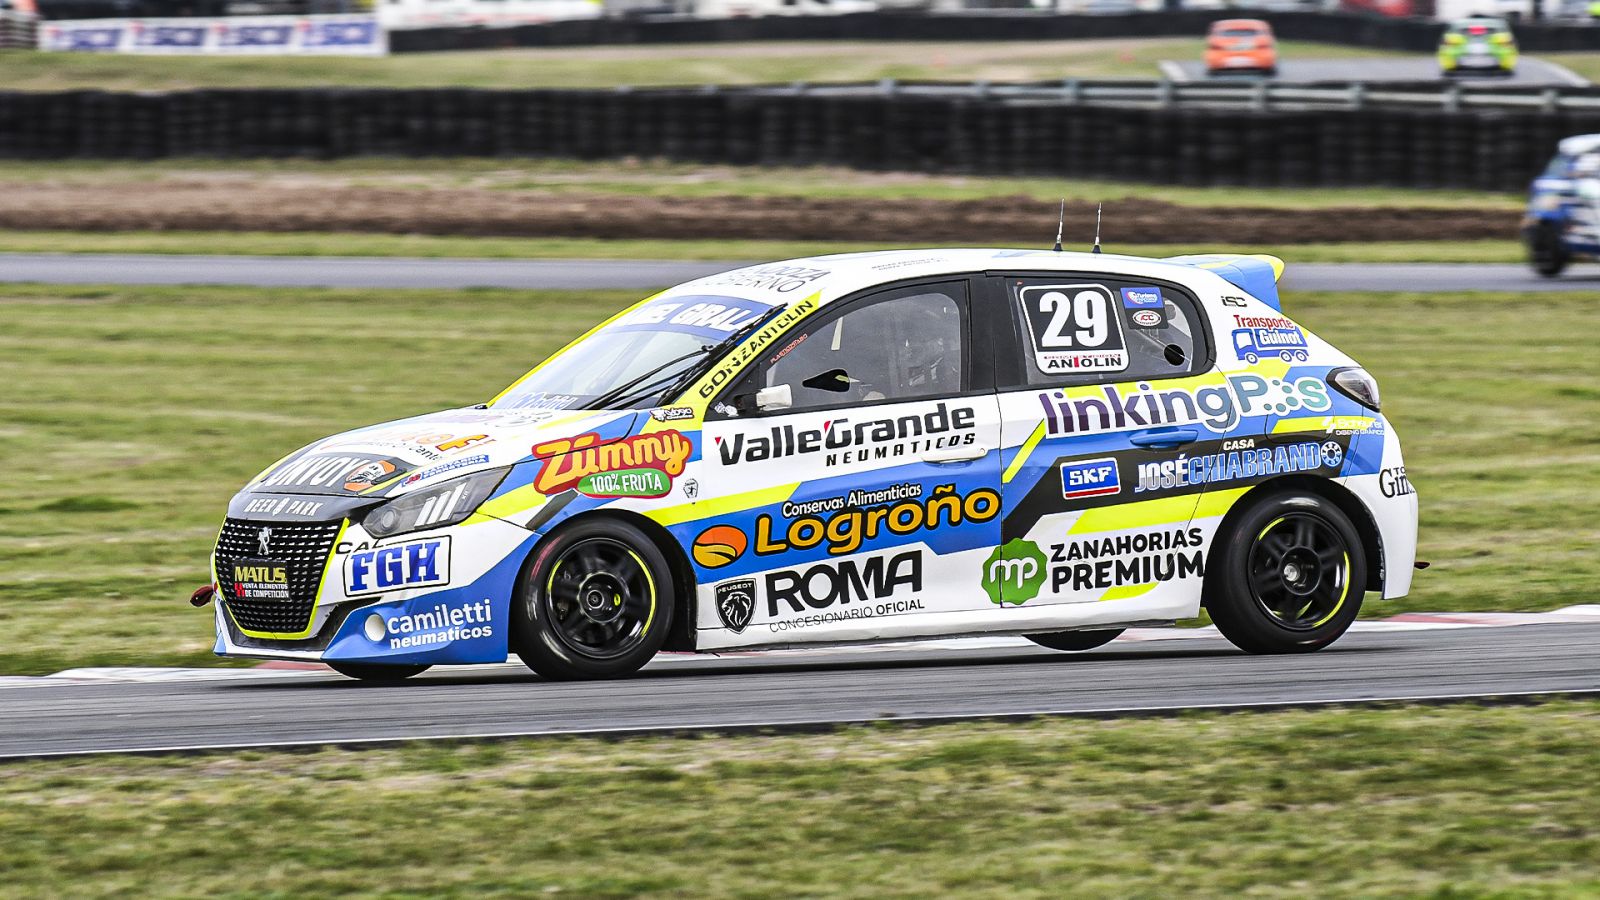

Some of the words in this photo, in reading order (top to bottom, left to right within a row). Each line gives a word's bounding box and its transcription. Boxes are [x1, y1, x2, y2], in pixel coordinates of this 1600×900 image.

[1039, 290, 1109, 347] 29
[1233, 314, 1294, 330] Transporte
[826, 432, 976, 467] NEUMATICOS
[1223, 438, 1255, 451] CASA
[589, 473, 621, 494] 100%
[622, 472, 664, 493] FRUTA
[1069, 465, 1113, 486] SKF
[285, 500, 324, 517] PARK
[782, 497, 845, 519] Conservas
[847, 482, 922, 507] Alimenticias
[755, 485, 1001, 555] Logroño
[1050, 527, 1202, 563] ZANAHORIAS
[234, 566, 286, 583] MATUS
[350, 541, 441, 591] FGH
[765, 550, 922, 617] ROMA
[1052, 550, 1204, 594] PREMIUM
[245, 590, 252, 598] DE
[717, 582, 753, 594] PEUGEOT
[386, 598, 493, 635] camiletti
[769, 606, 873, 633] CONCESIONARIO
[875, 598, 925, 618] OFICIAL
[390, 625, 493, 650] neumaticos
